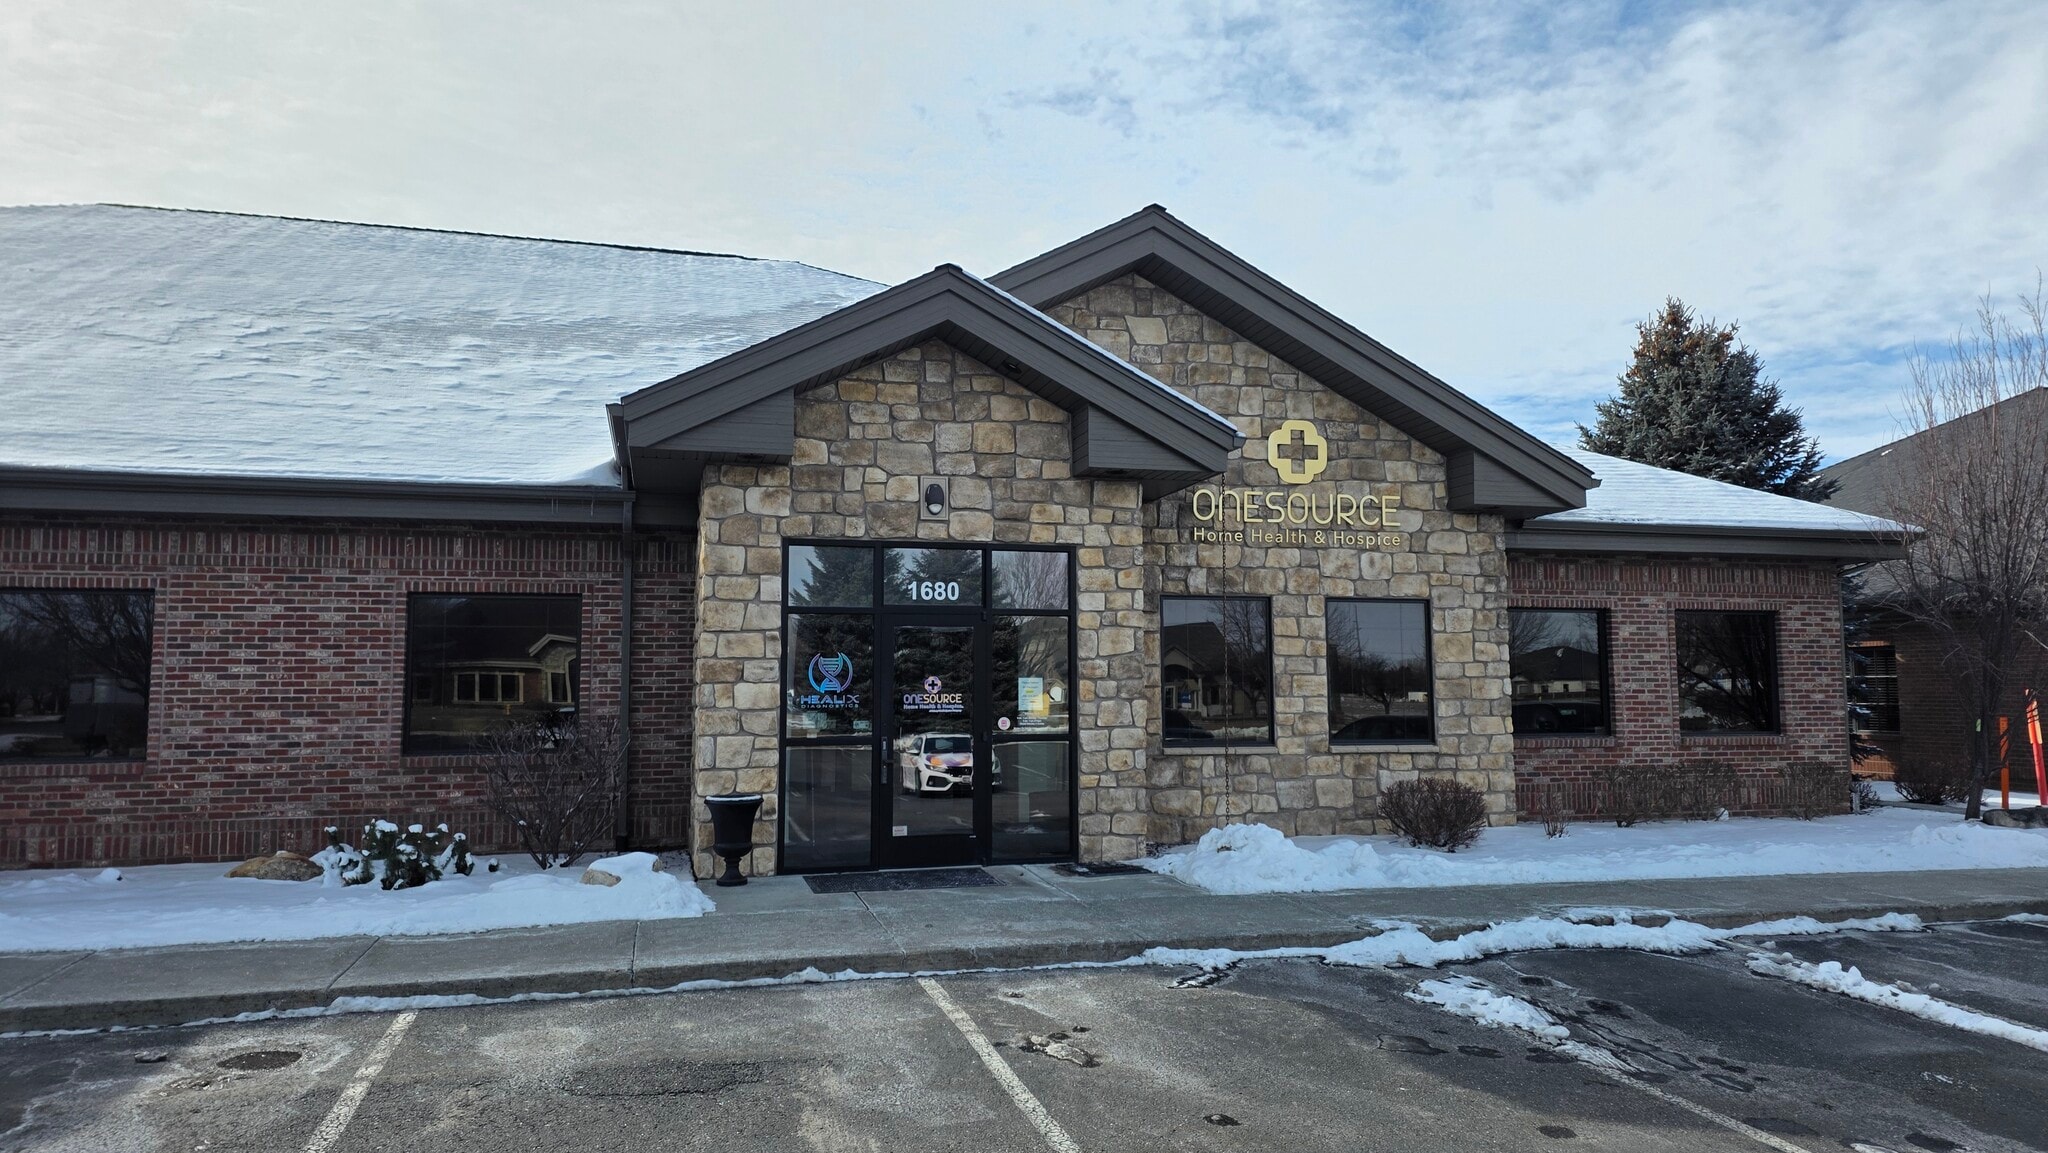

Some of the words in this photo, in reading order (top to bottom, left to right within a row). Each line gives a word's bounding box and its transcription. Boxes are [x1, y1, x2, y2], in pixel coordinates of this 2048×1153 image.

[1193, 489, 1401, 526] ONESOURCE
[1193, 527, 1243, 542] Home
[1251, 529, 1307, 544] Health
[1314, 530, 1326, 544] &
[1334, 531, 1401, 549] Hospice
[908, 581, 960, 600] 1680
[801, 694, 860, 704] HEALIX
[903, 693, 963, 704] ONESOURCE
